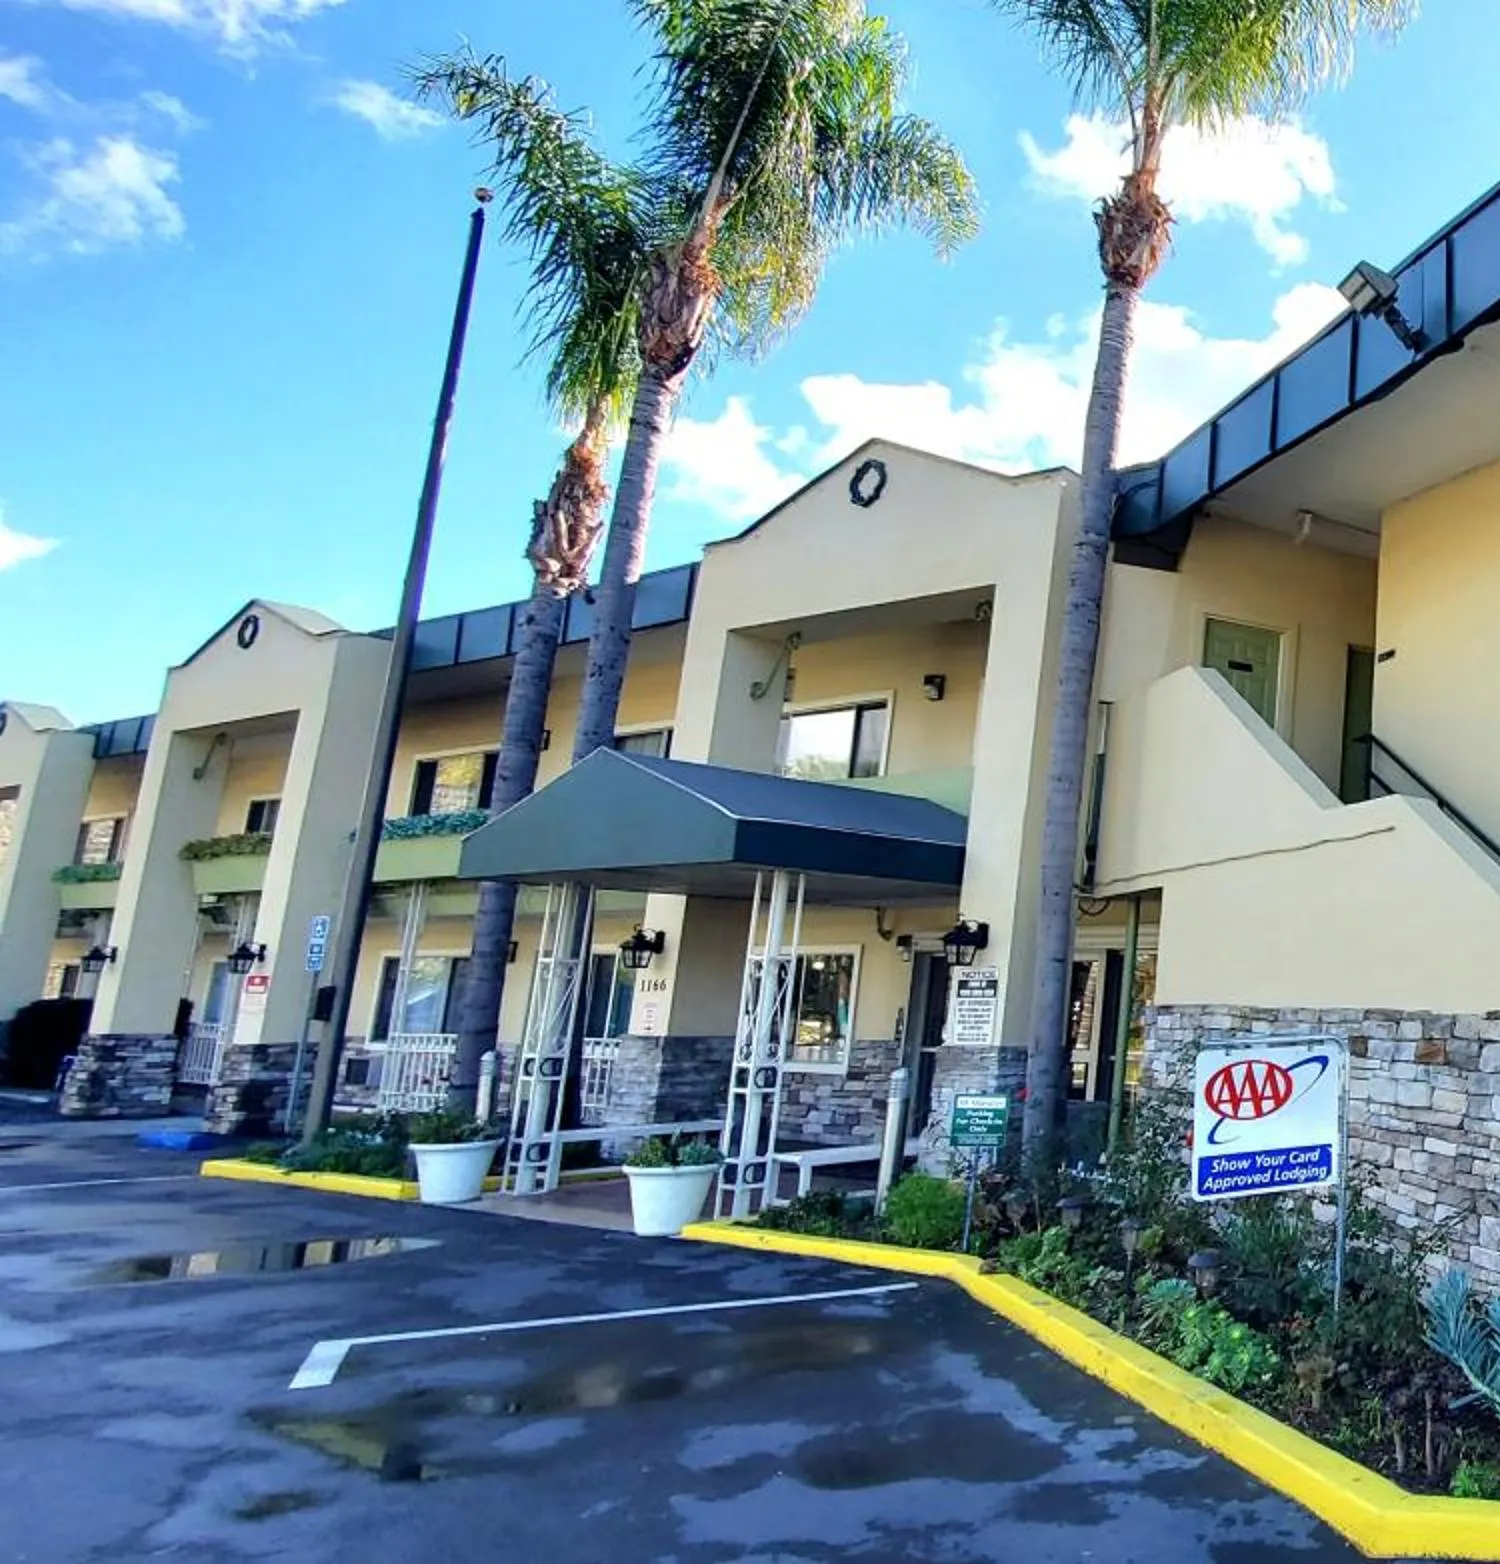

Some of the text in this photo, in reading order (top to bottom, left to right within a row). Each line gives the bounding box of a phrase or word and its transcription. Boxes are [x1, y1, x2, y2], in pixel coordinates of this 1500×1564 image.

[641, 979, 667, 992] 1166
[1209, 1061, 1288, 1119] AAA
[1211, 1149, 1320, 1173] Show Your Card
[1203, 1165, 1328, 1192] Approved Lodging
